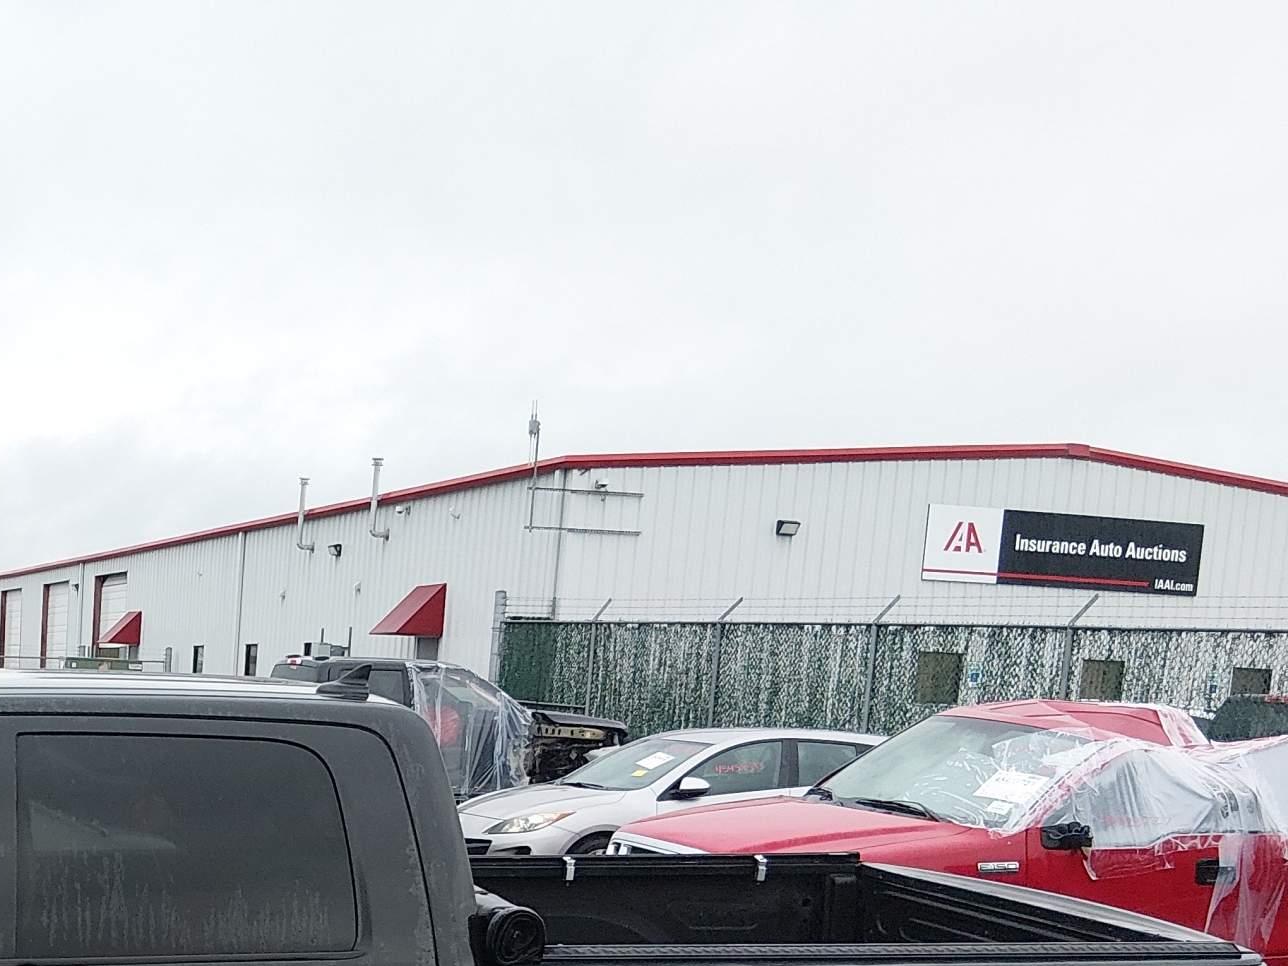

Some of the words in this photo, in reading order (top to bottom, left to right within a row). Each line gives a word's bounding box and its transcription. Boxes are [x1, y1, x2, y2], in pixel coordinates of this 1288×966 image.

[1014, 533, 1087, 555] Insurance
[1089, 539, 1122, 558] Auto
[1125, 541, 1187, 563] Auctions
[1154, 578, 1194, 592] IAAI.com
